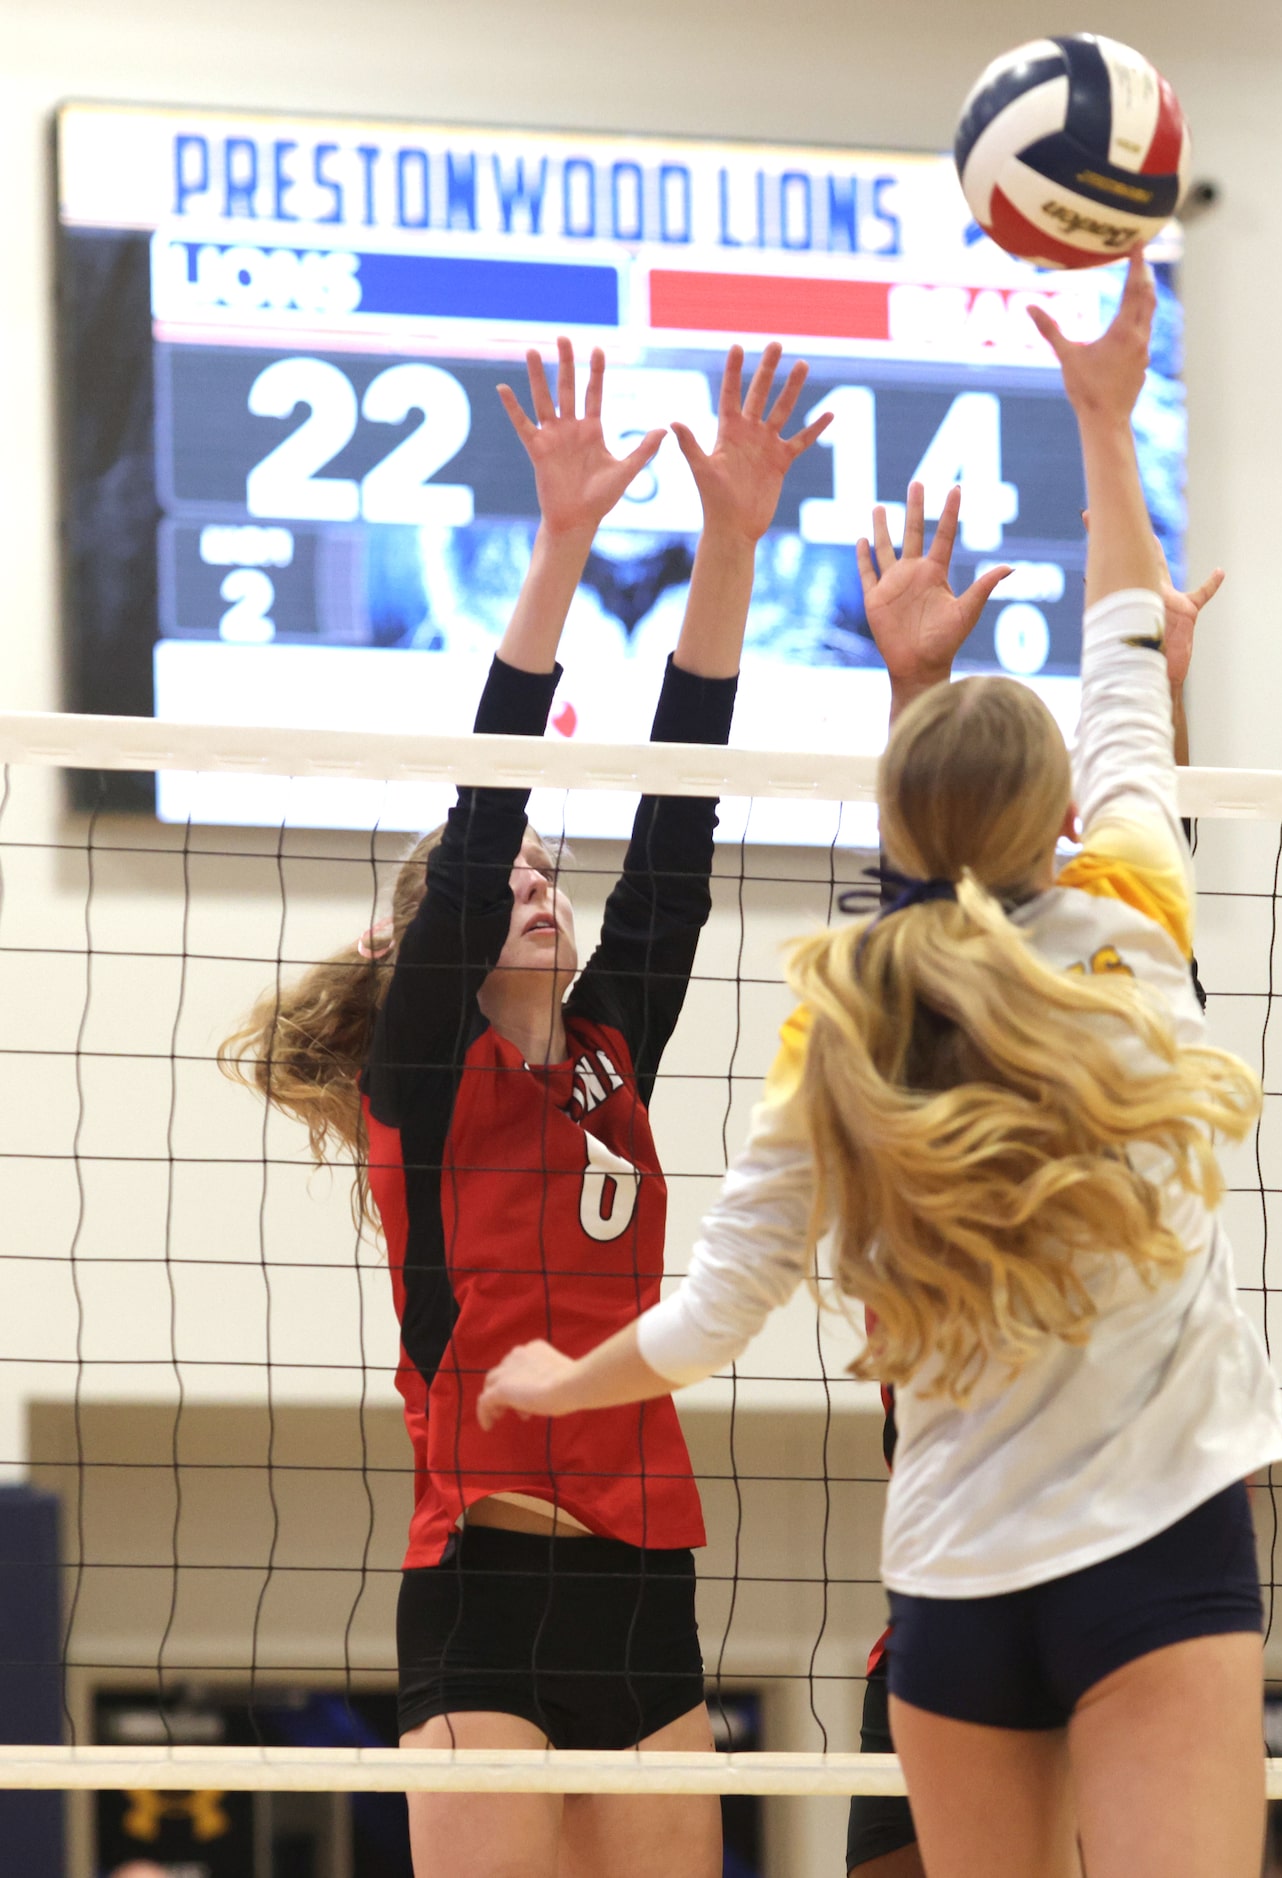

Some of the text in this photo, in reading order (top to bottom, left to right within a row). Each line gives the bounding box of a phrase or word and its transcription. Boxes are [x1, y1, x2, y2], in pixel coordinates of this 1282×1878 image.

[172, 132, 903, 257] PRESTONWOOD LIONS
[247, 356, 475, 526] 22
[799, 385, 1020, 551] 14
[219, 568, 276, 643] 2
[994, 602, 1050, 675] 0
